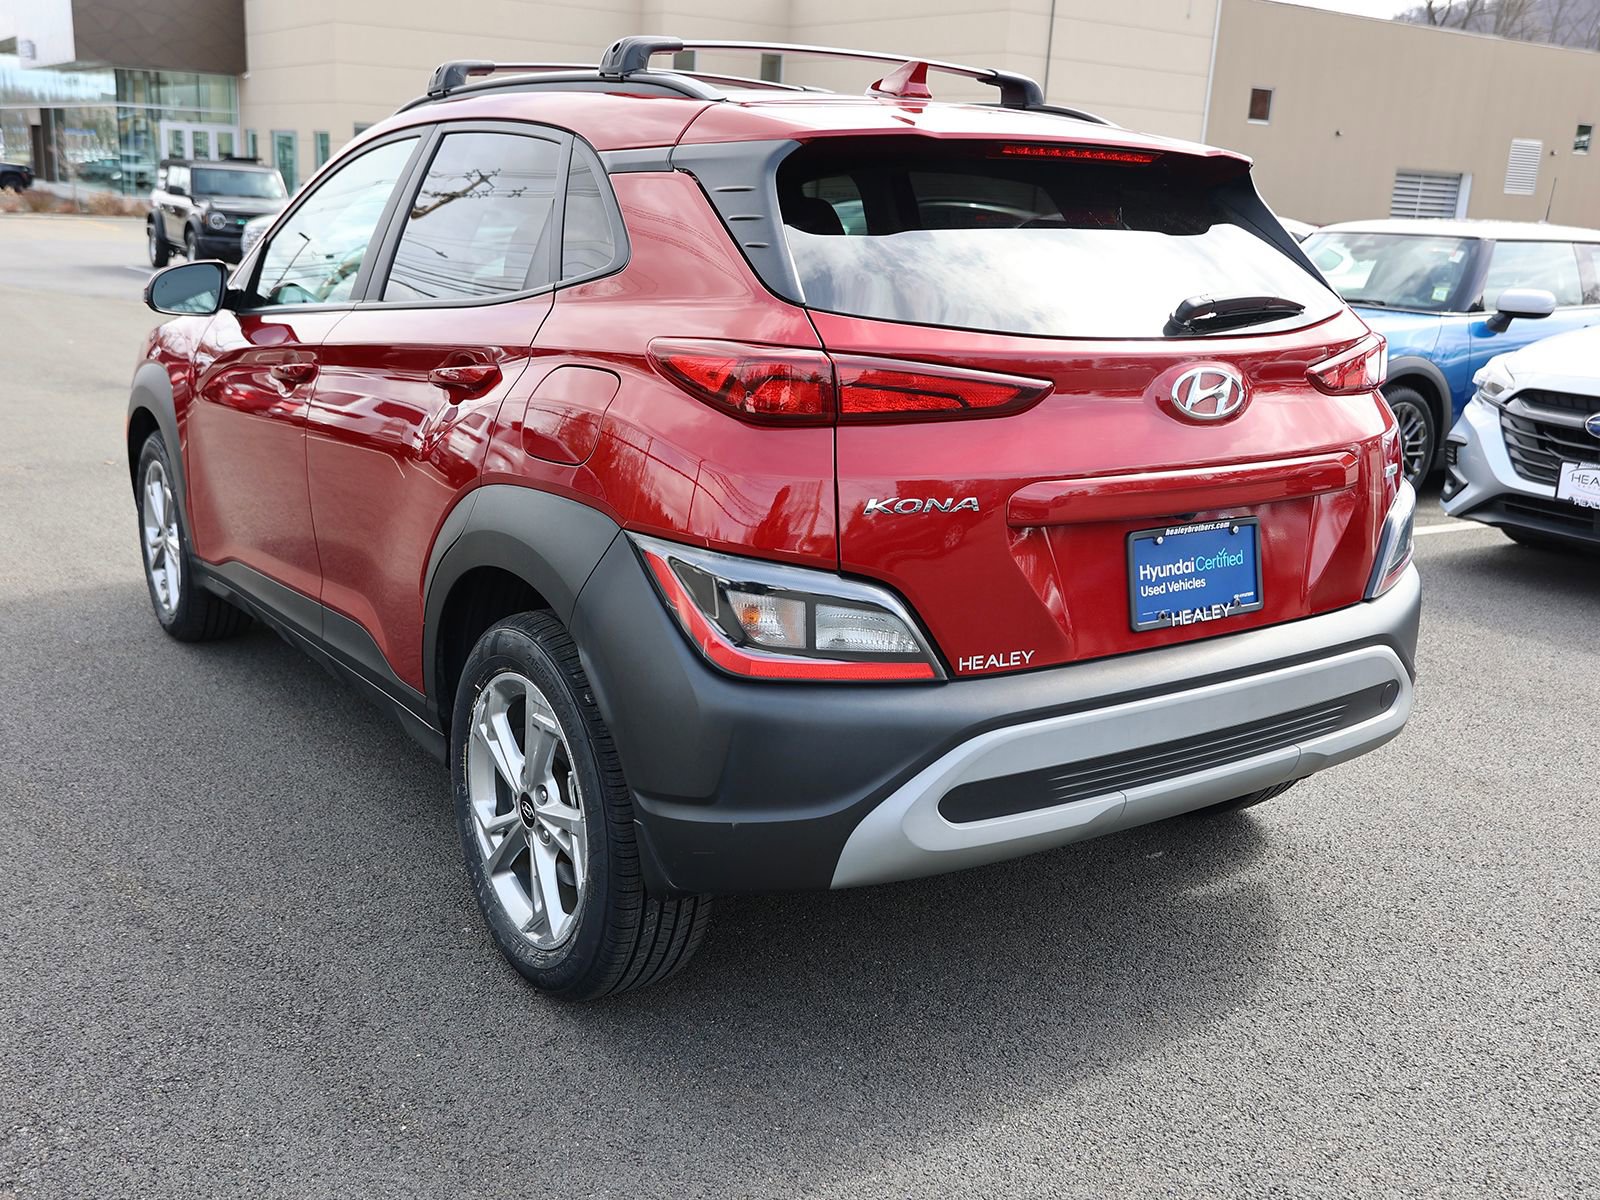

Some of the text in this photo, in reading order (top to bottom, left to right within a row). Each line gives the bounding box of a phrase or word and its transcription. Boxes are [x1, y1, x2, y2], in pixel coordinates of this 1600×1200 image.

[864, 496, 980, 515] KONA
[1165, 522, 1230, 536] healeybrothers.com
[1139, 548, 1244, 582] Hyundai Certified
[1140, 577, 1206, 597] Used Vehicles
[1171, 603, 1232, 627] HEALEY
[958, 649, 1035, 672] HEALEY
